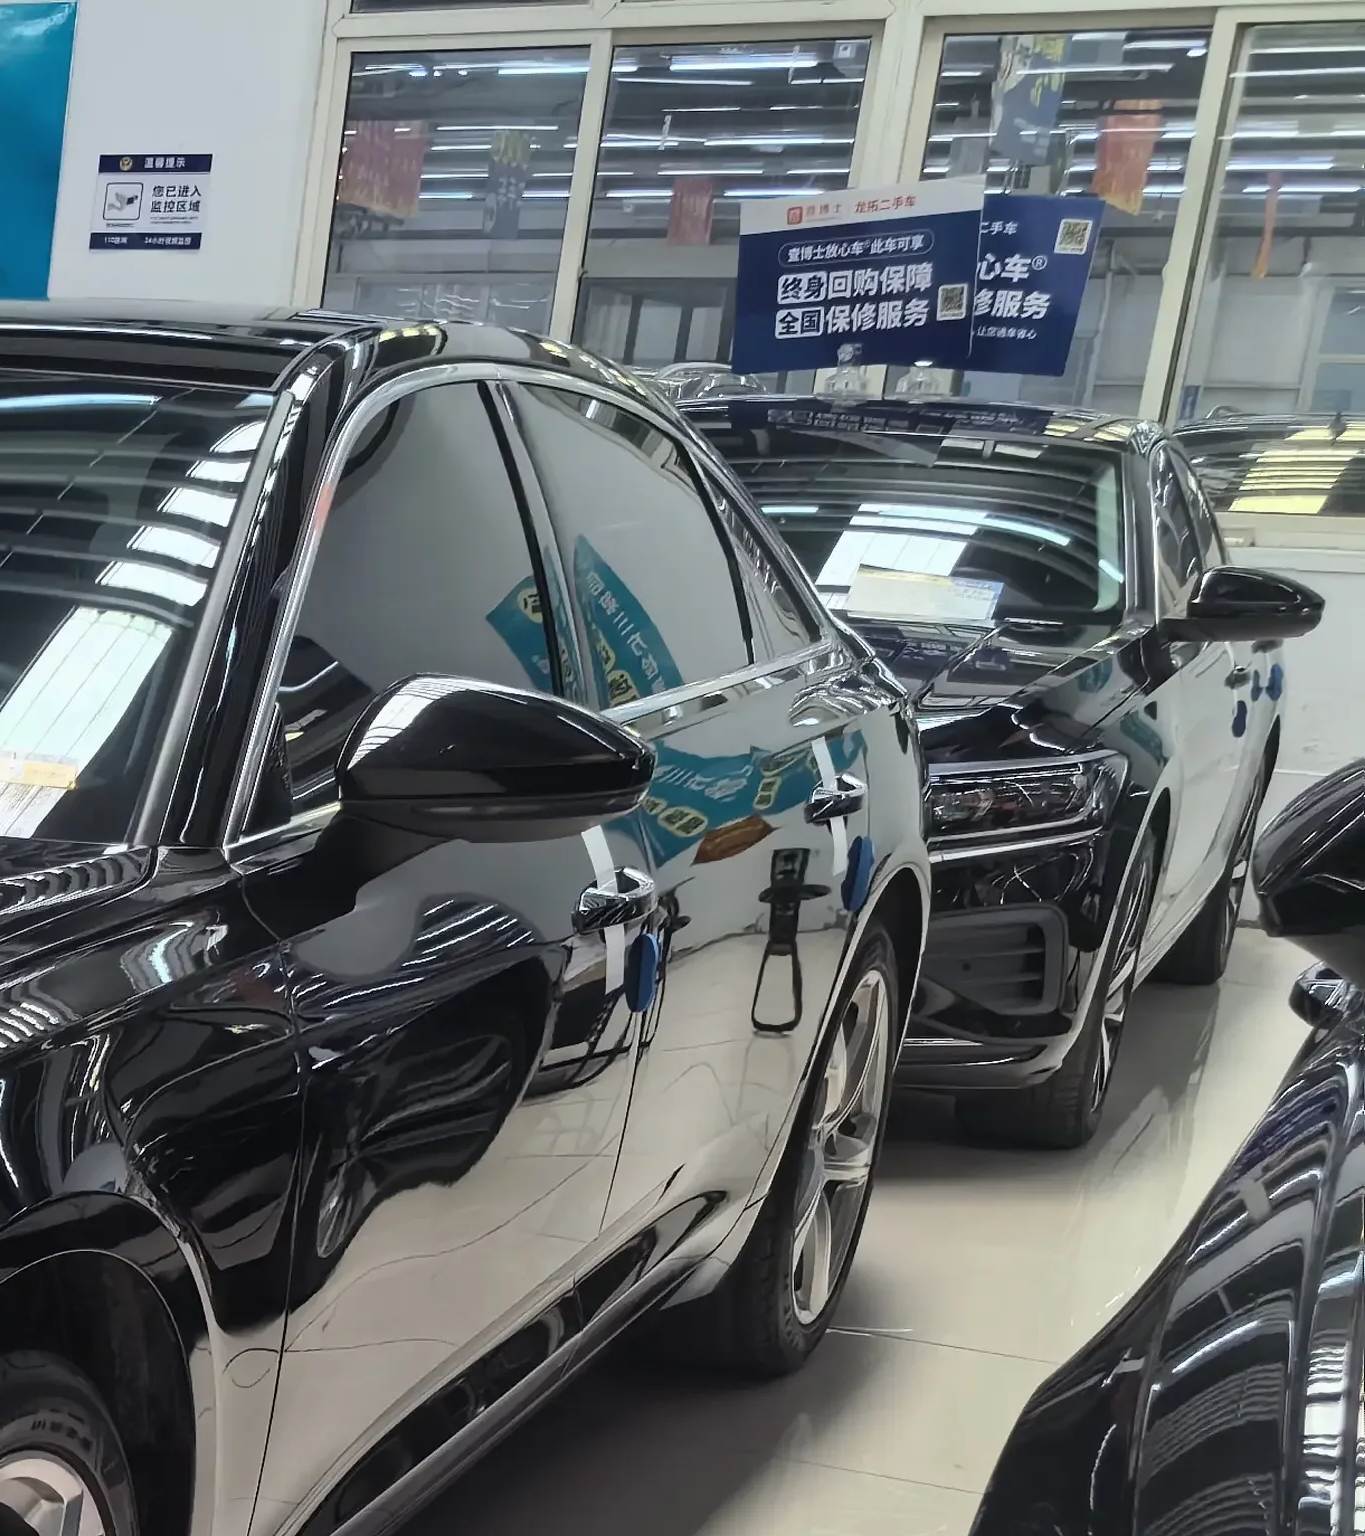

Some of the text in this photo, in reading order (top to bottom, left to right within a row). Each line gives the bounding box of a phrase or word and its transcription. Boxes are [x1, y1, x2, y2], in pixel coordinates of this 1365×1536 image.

[152, 184, 202, 198] 您已进入
[150, 200, 201, 213] 监控区域
[778, 262, 933, 304] 终身回购保障
[775, 299, 930, 339] 全国保修服务
